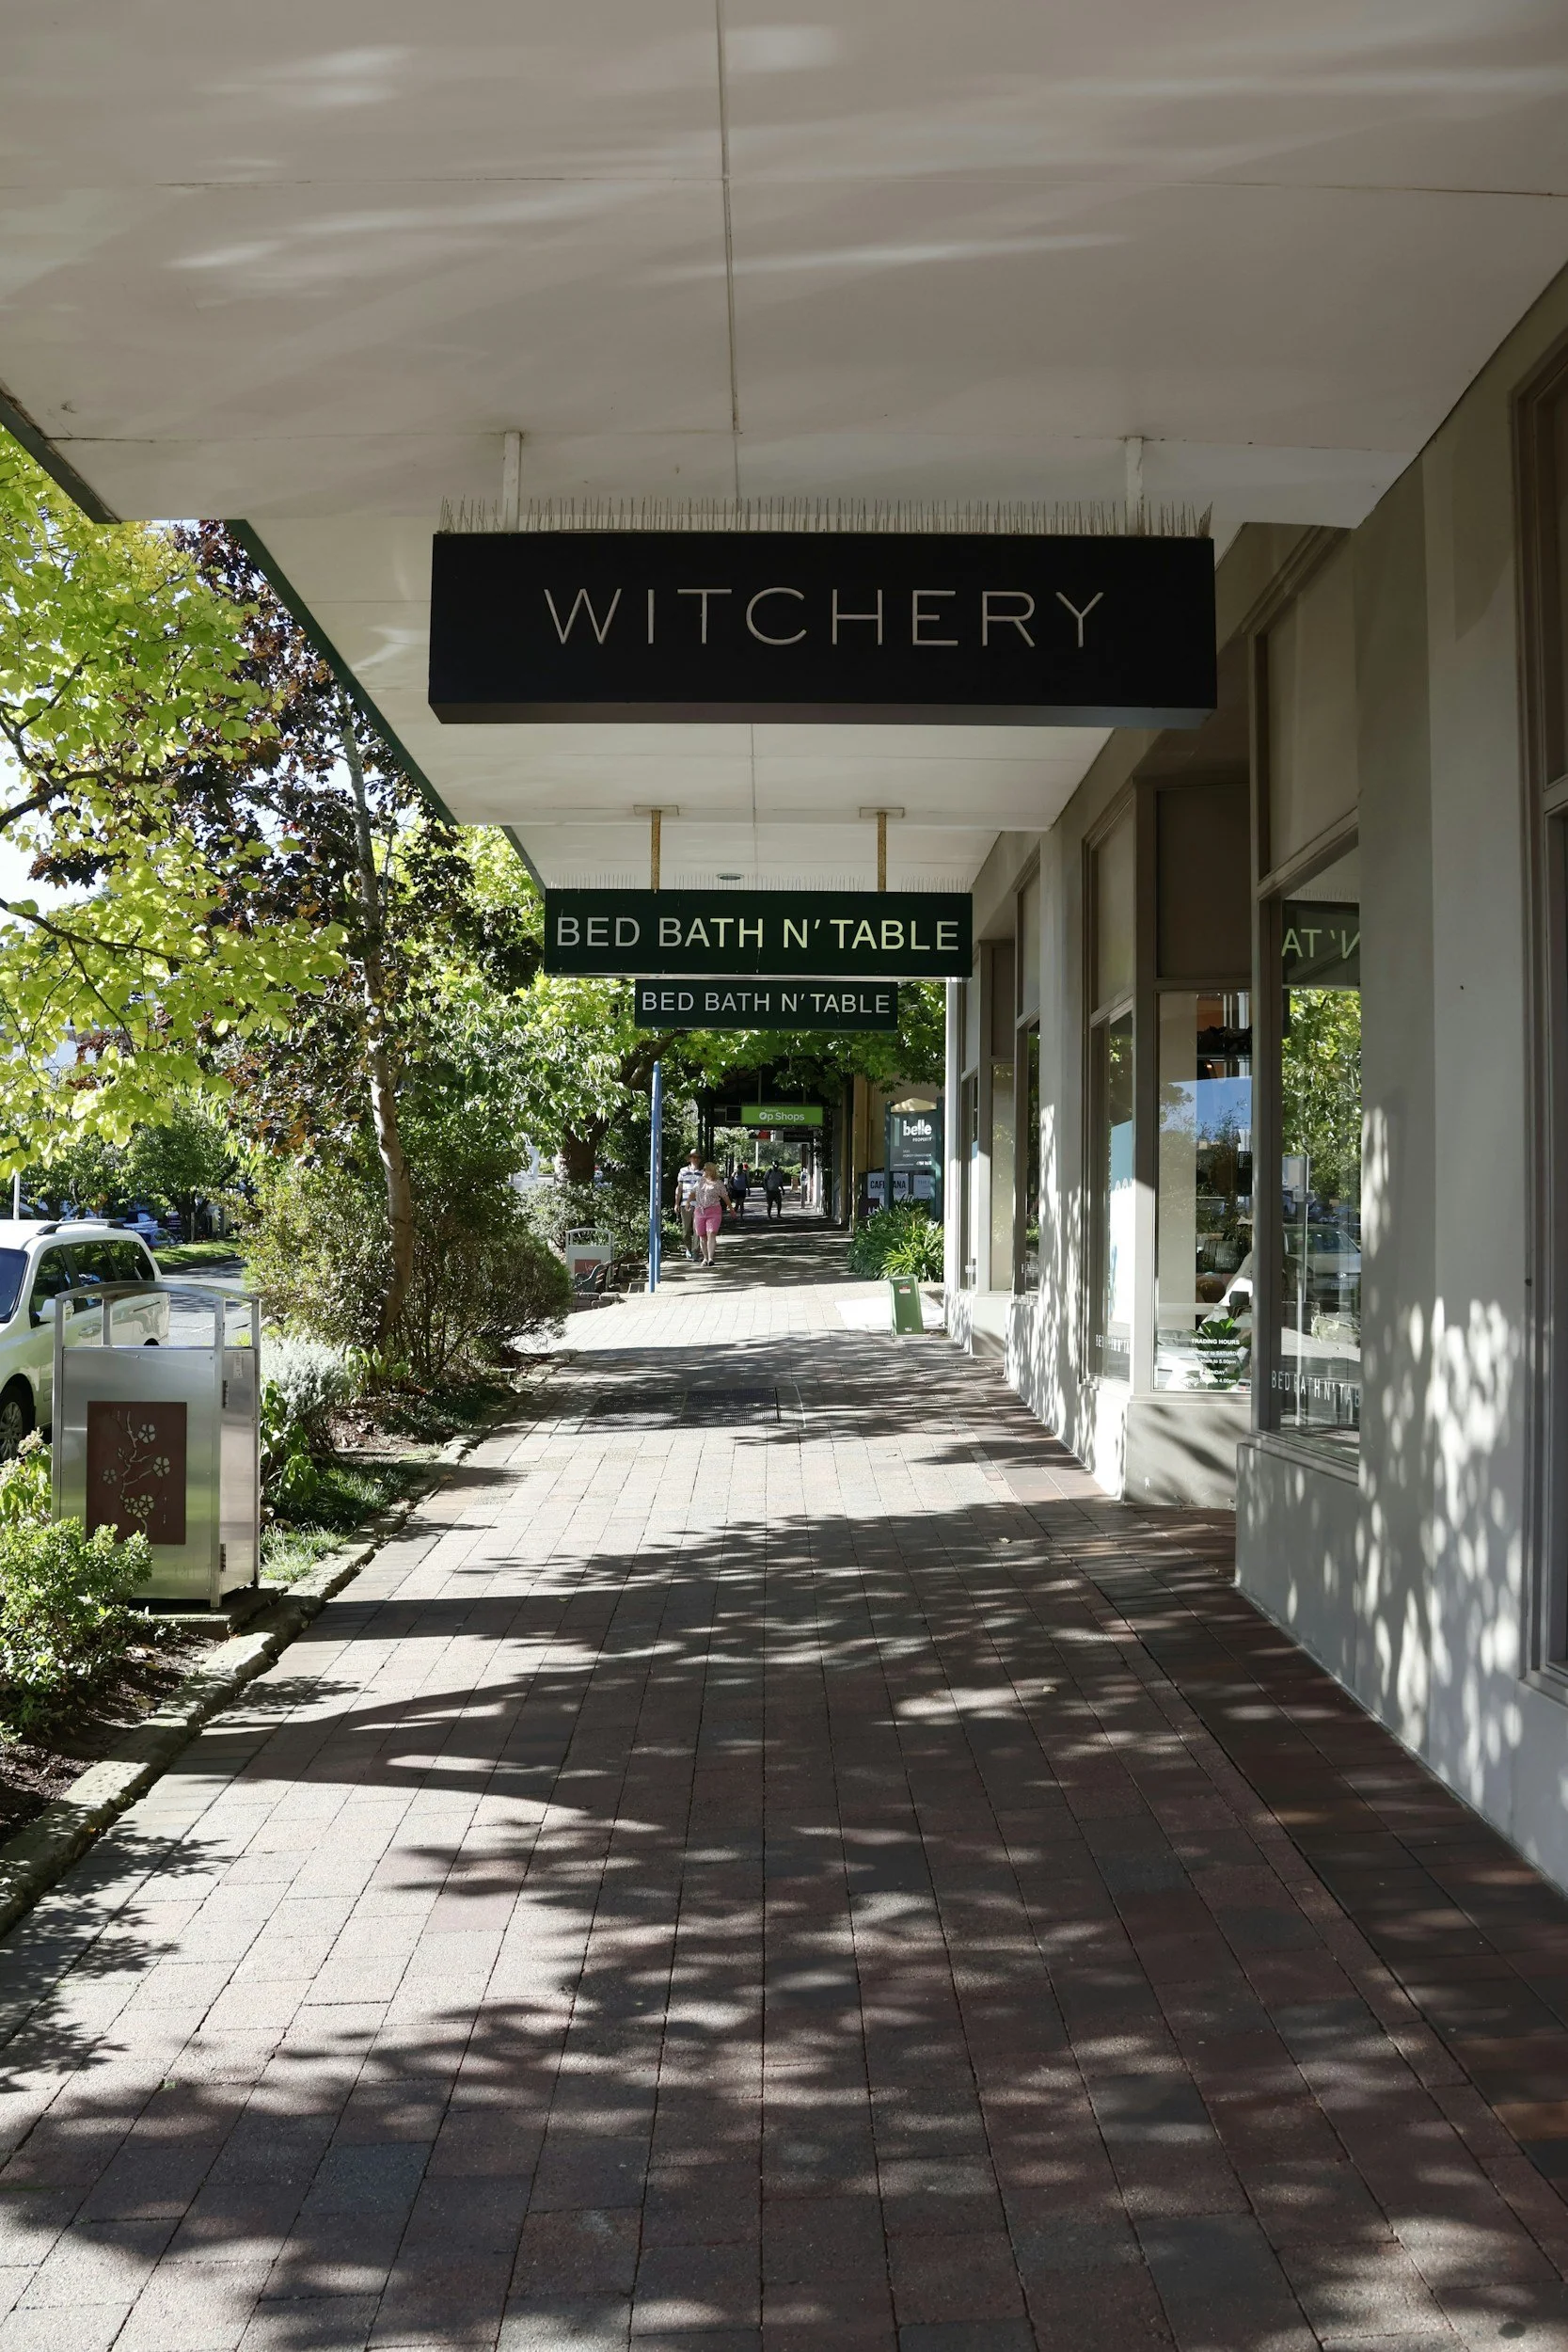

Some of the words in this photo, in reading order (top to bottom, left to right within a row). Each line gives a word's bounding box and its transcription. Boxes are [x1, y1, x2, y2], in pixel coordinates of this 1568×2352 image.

[544, 586, 1104, 647] WITCHERY
[557, 917, 641, 946] BED
[658, 917, 763, 947] BATH
[641, 992, 694, 1011] BED
[705, 992, 769, 1012] BATH
[758, 1112, 774, 1121] Op
[775, 1111, 805, 1122] Shops
[903, 1120, 932, 1136] belle
[1272, 1370, 1290, 1391] BED
[1294, 1374, 1321, 1399] BATH
